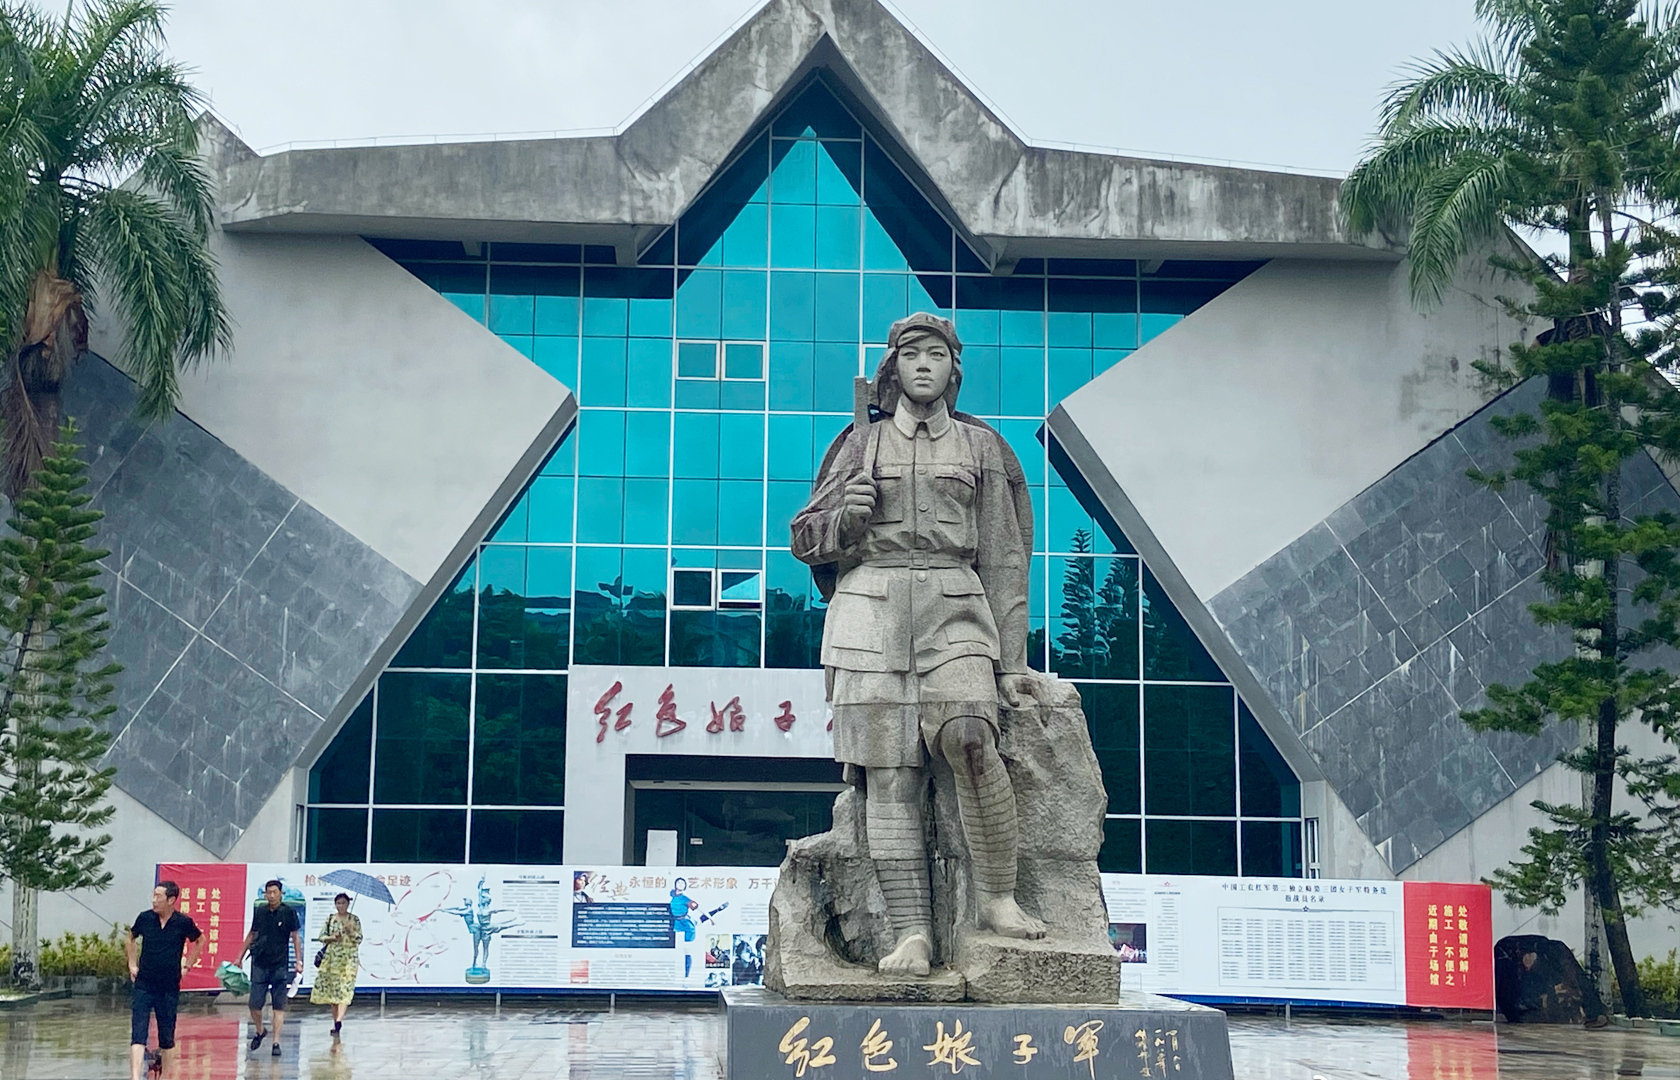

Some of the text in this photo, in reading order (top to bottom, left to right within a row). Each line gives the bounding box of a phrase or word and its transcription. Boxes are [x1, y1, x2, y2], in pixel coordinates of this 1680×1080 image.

[594, 681, 833, 743] 红色娘子
[590, 873, 778, 901] 经典 永恒的 艺术形象 万千
[1428, 904, 1439, 985] 近期由于场馆
